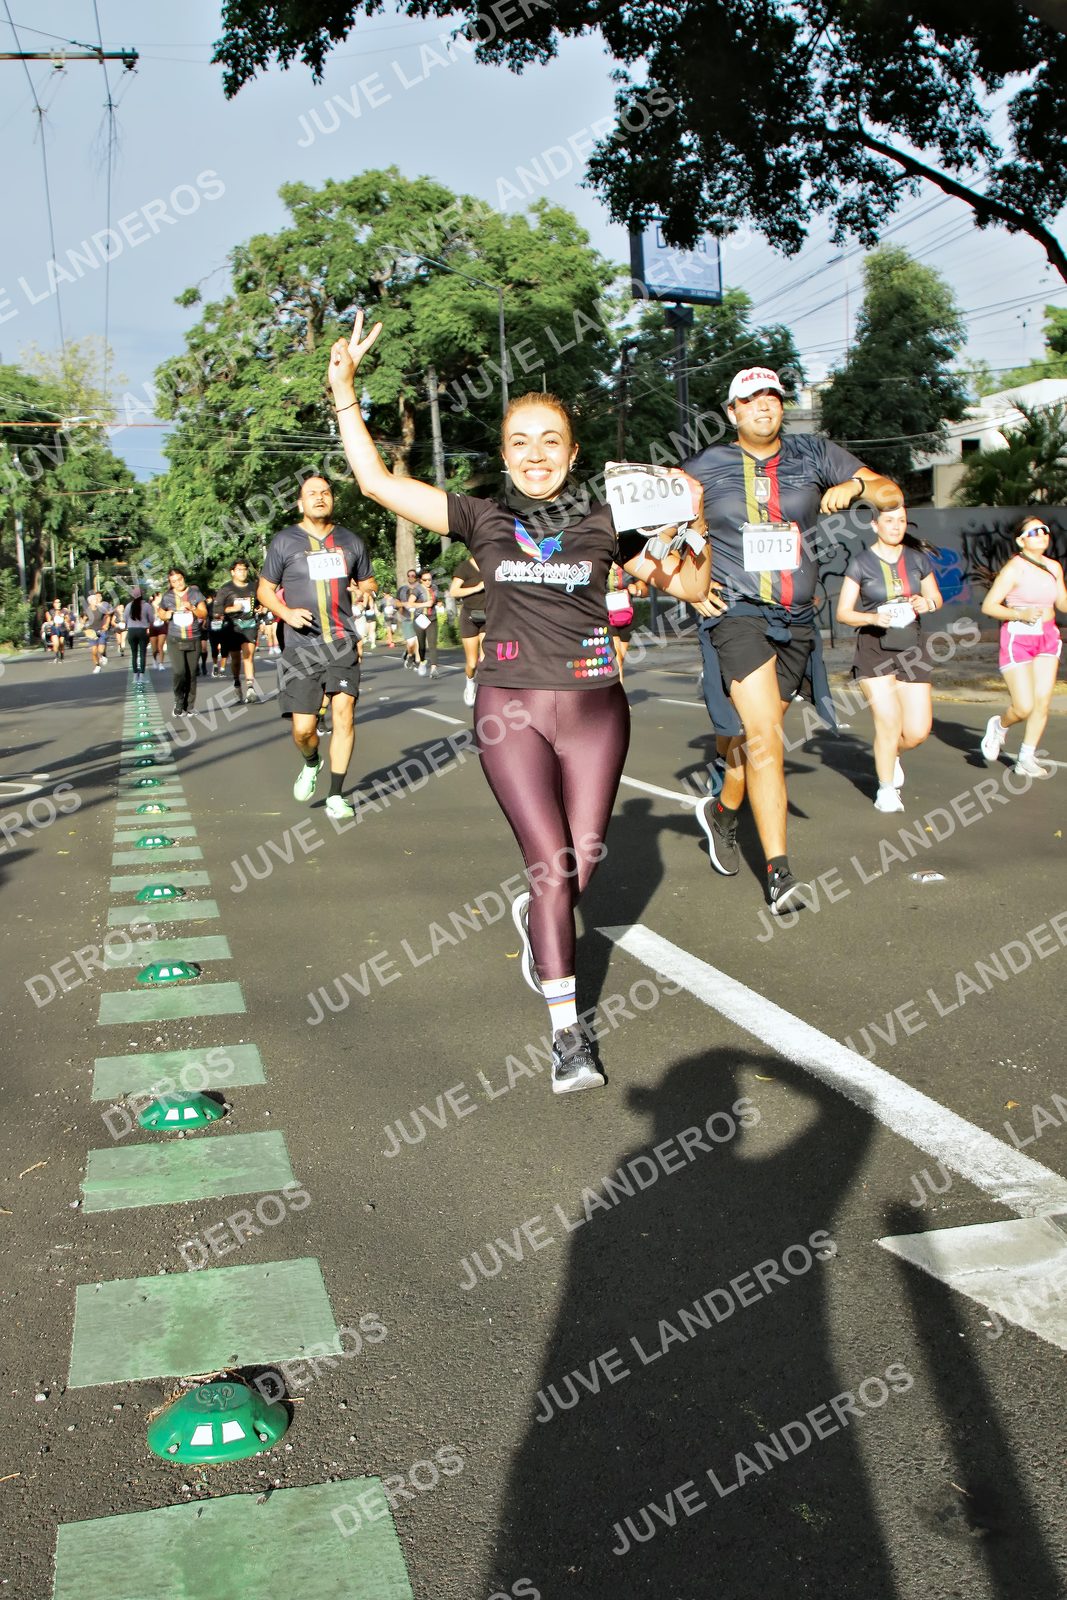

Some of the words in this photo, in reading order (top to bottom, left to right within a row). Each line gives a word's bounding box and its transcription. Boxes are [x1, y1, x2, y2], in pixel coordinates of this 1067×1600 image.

[612, 478, 684, 505] 12806
[747, 537, 793, 554] 10715
[497, 641, 519, 661] LU
